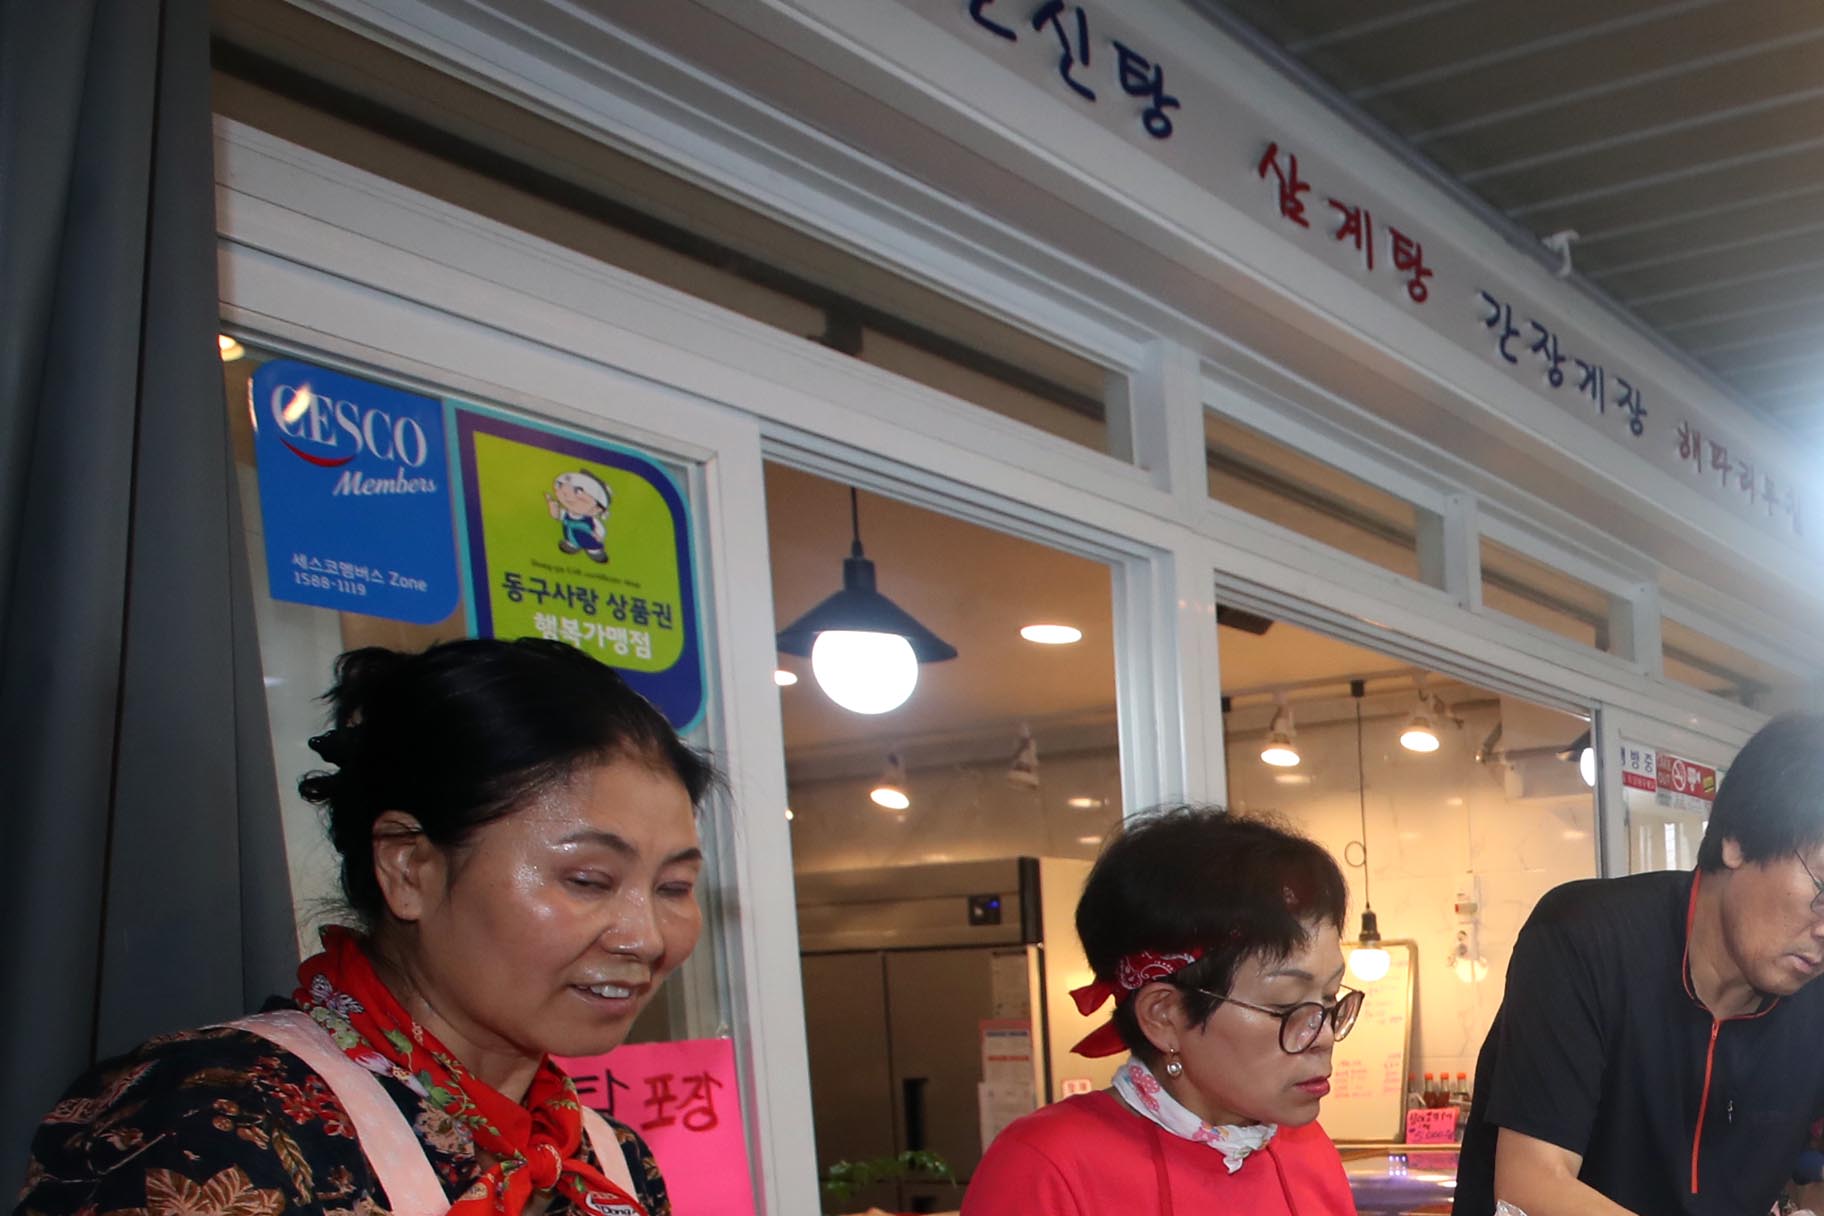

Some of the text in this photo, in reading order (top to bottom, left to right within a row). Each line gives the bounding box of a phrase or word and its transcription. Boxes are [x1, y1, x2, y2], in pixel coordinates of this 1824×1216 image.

[1258, 141, 1434, 302] 삼계탕
[1480, 290, 1648, 436] 간장게장
[271, 384, 428, 468] CESCO
[331, 466, 438, 496] Members
[294, 571, 367, 596] 1588-1119
[389, 570, 428, 592] Zone
[502, 571, 599, 616] 동구사랑
[606, 592, 673, 630] 상품권
[534, 611, 653, 660] 행복가맹점
[640, 1071, 724, 1133] 포장
